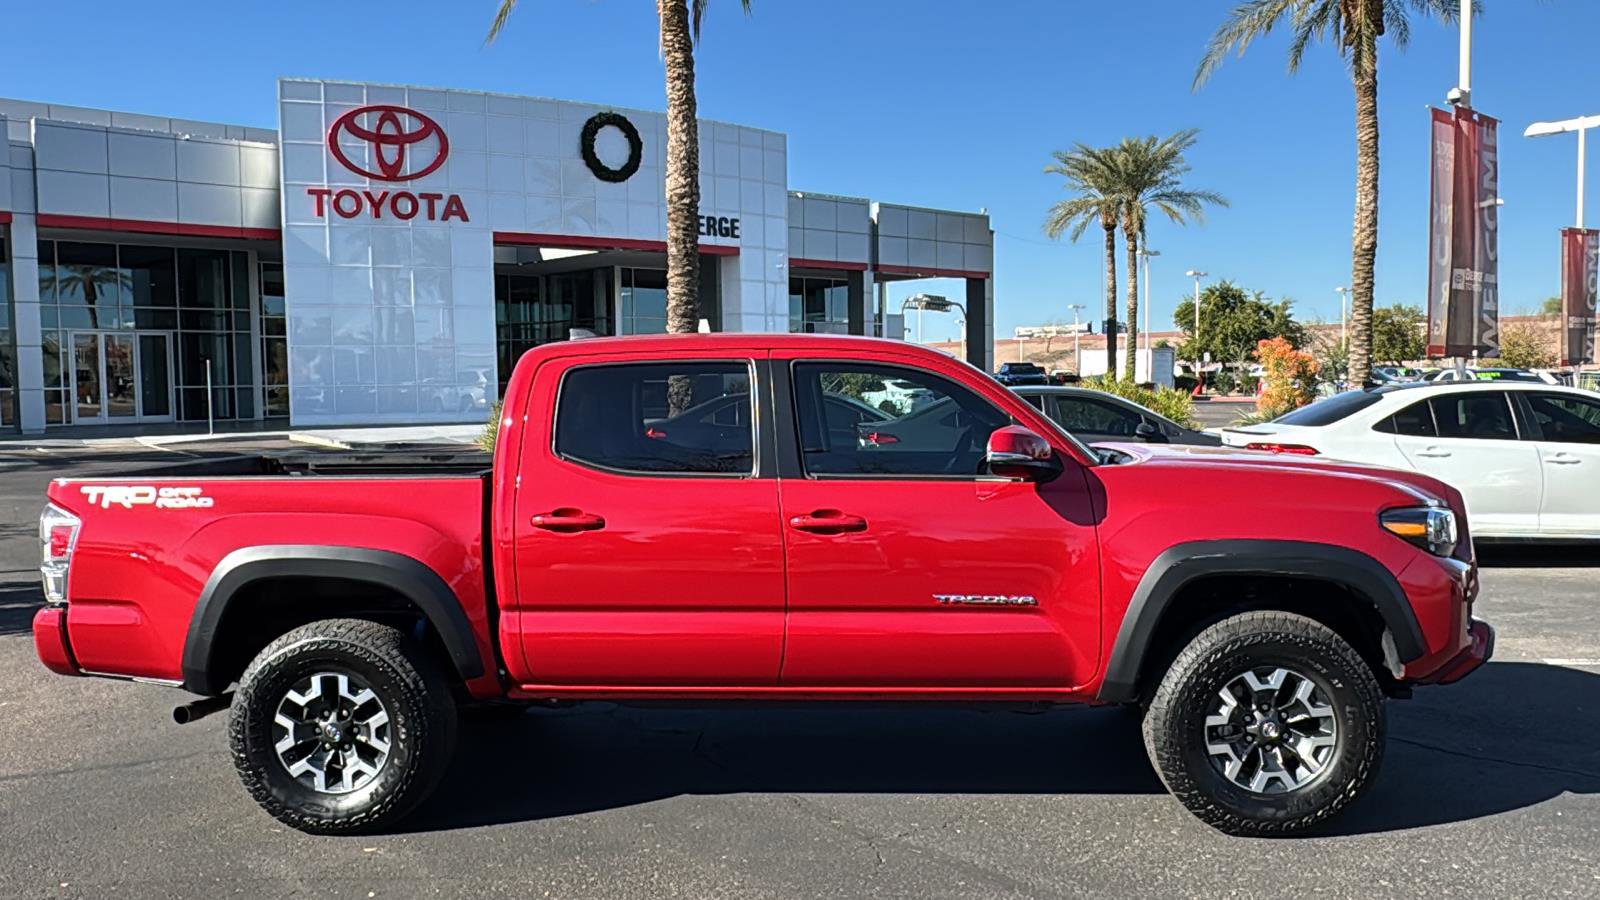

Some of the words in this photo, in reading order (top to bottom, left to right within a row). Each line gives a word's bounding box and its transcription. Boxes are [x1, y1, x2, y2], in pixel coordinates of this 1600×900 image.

[307, 188, 470, 222] TOYOTA
[697, 215, 740, 239] ERGE
[1482, 122, 1499, 358] WELCOME
[80, 485, 157, 509] TRD
[155, 497, 214, 509] ROAD
[158, 486, 203, 498] OFF
[932, 594, 1036, 605] TACOMA
